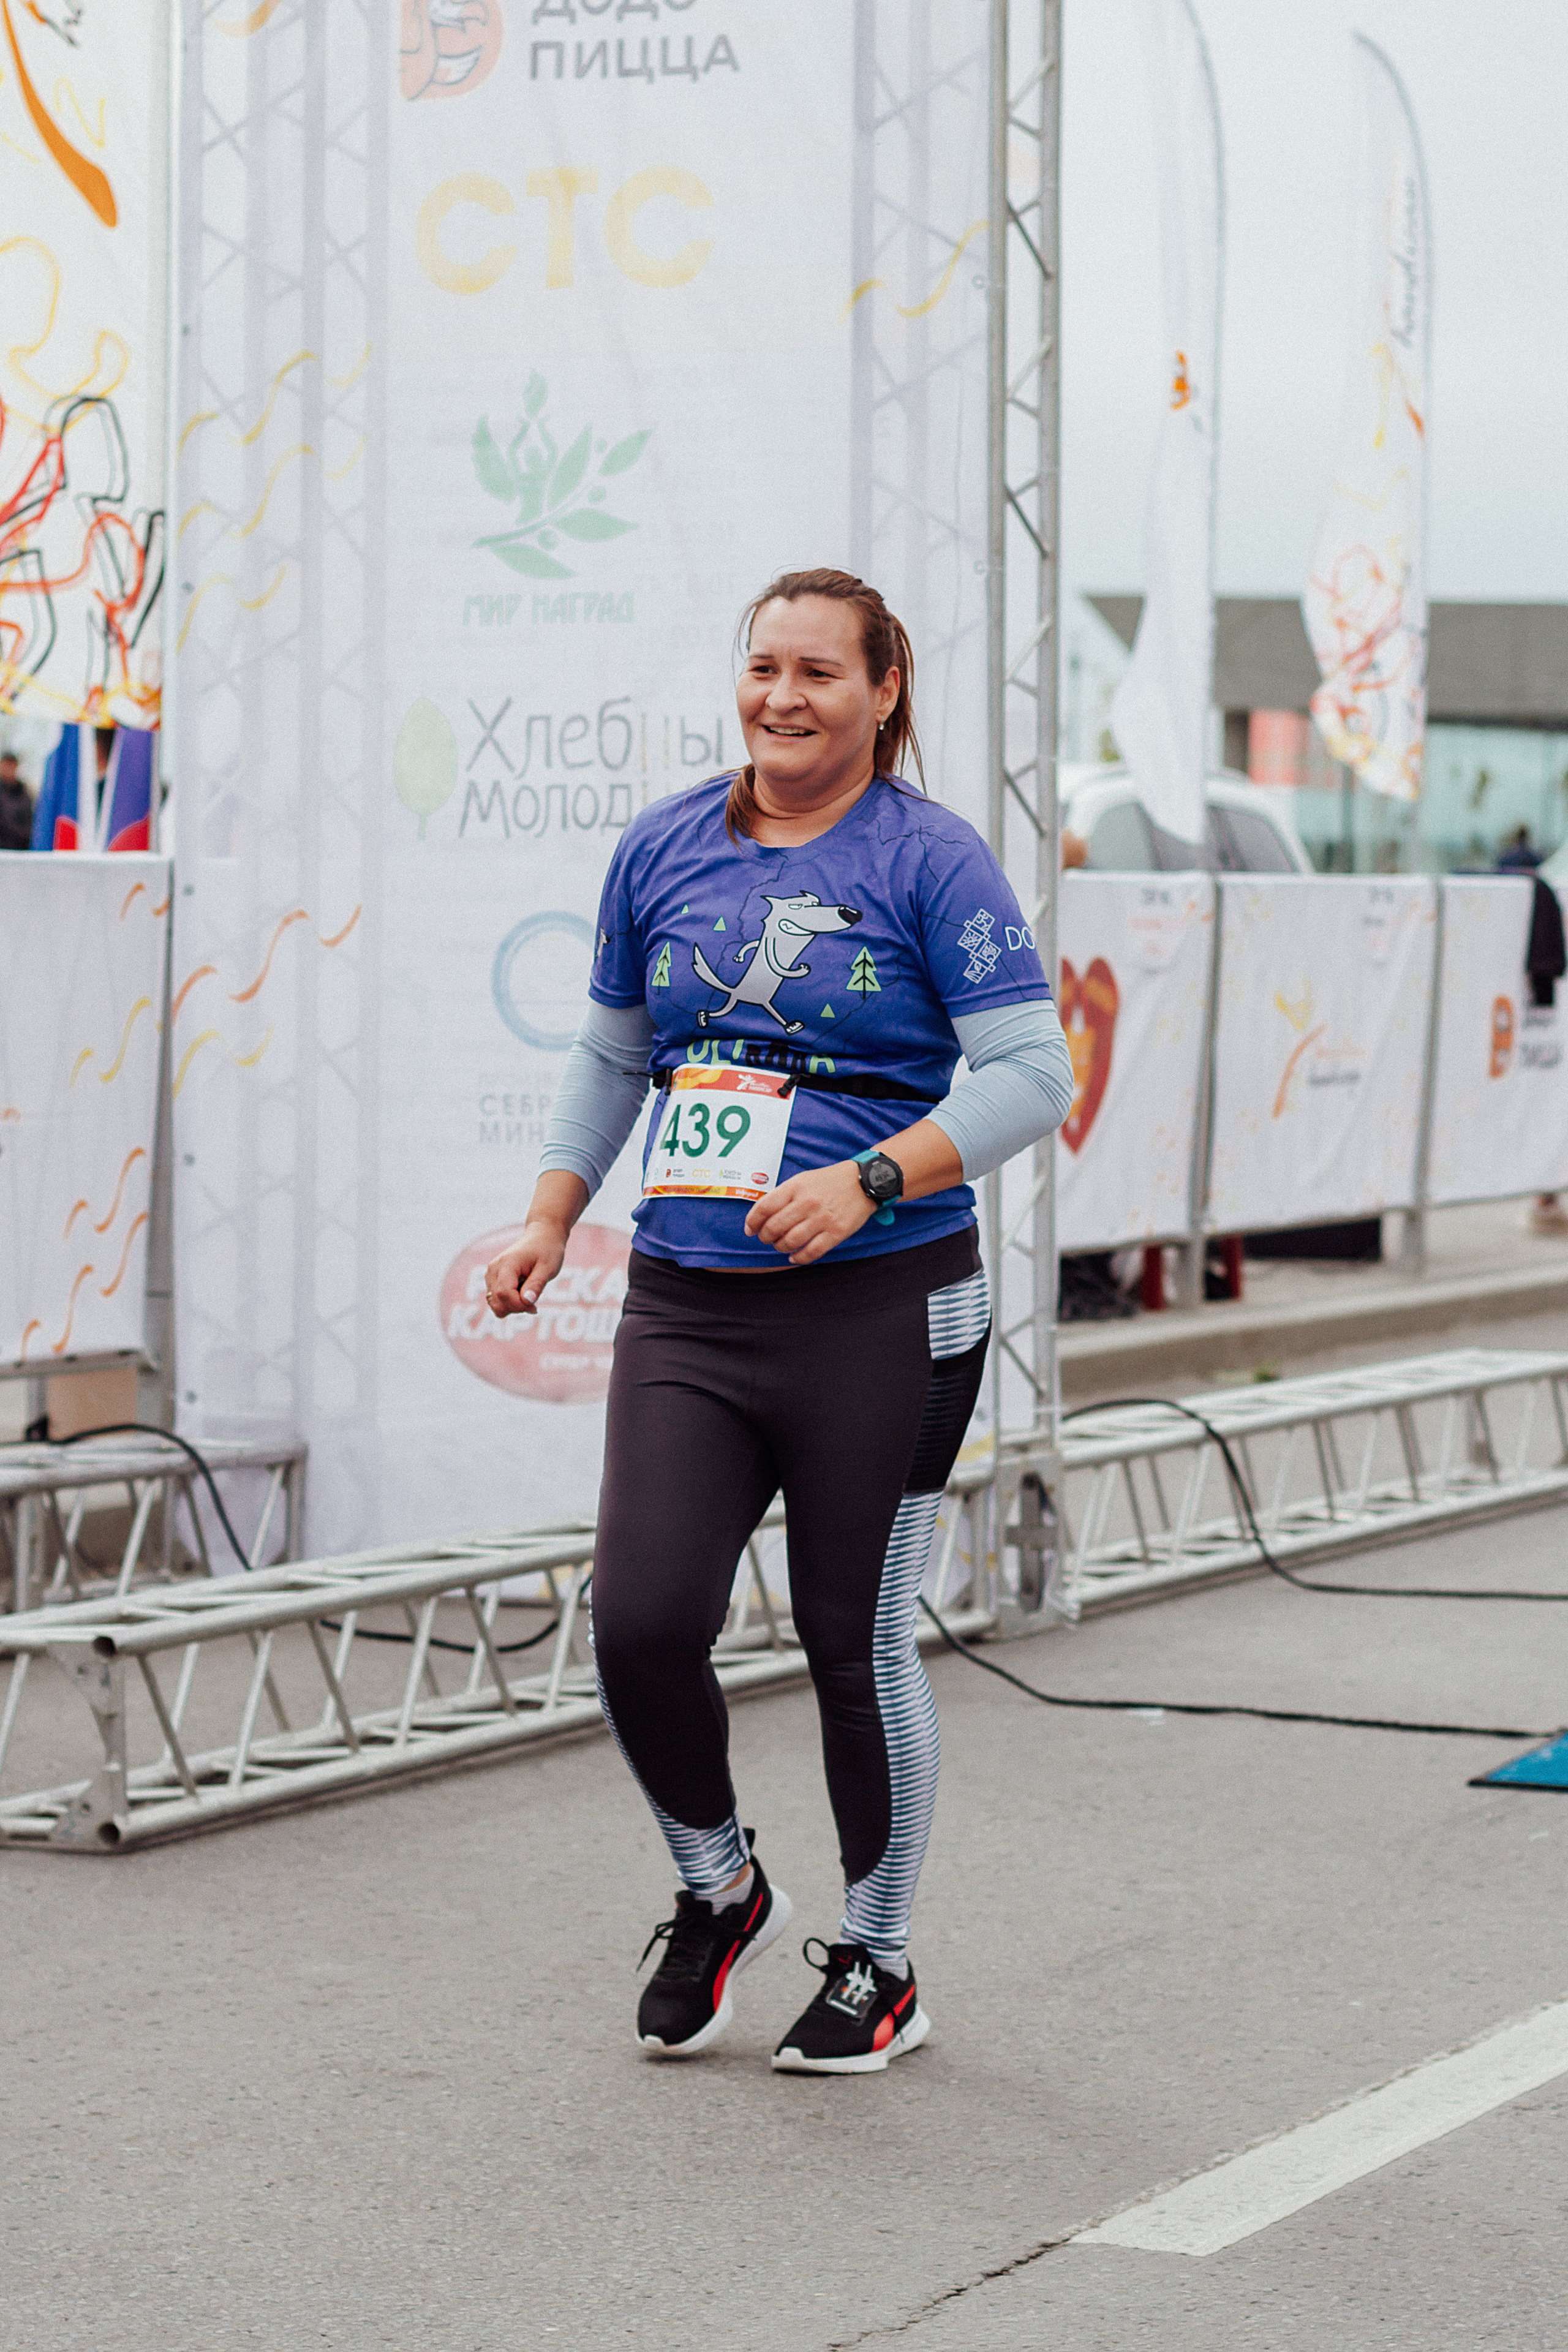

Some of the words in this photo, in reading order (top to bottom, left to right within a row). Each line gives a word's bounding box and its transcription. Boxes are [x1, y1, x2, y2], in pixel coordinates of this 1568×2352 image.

[530, 34, 740, 84] ПИЦЦА
[415, 165, 717, 295] СТС
[462, 594, 521, 626] МИР
[532, 592, 635, 624] НАГРАД
[1005, 926, 1035, 951] DO
[478, 1093, 551, 1116] СЕБР
[478, 1121, 545, 1144] МИН
[660, 1102, 751, 1158] 439
[448, 1303, 621, 1343] КАРТОШ
